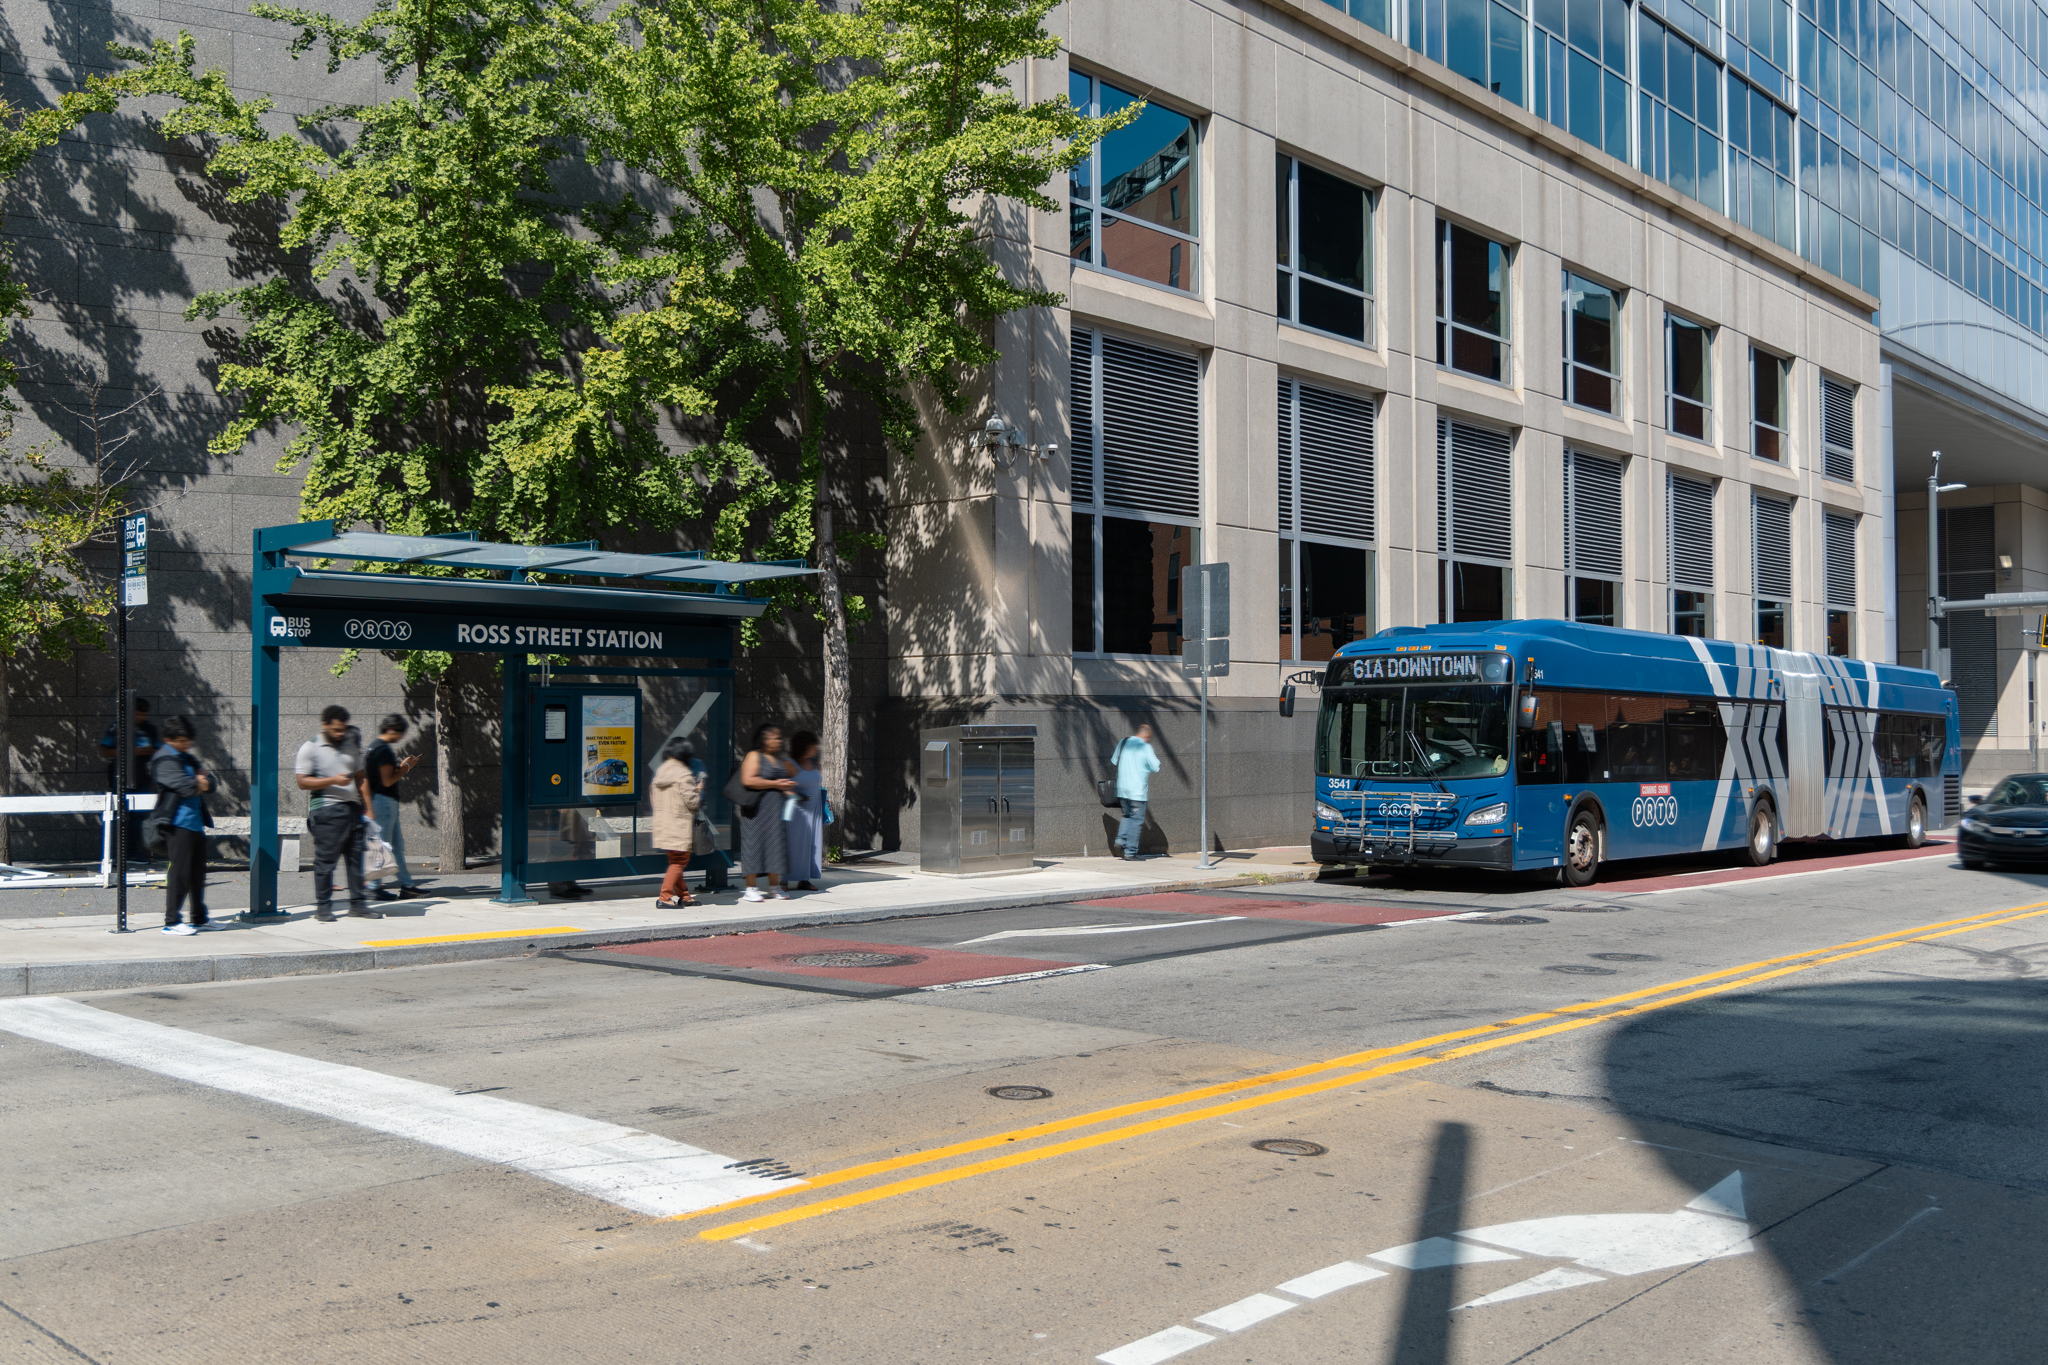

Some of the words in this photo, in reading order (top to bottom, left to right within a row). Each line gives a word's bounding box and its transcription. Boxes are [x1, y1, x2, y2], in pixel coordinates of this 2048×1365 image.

[126, 519, 136, 530] BUS
[126, 530, 136, 540] STOP
[287, 617, 311, 628] BUS
[287, 628, 311, 638] STOP
[346, 620, 411, 639] PRTX
[458, 623, 510, 644] ROSS
[515, 626, 583, 647] STREET
[586, 629, 663, 649] STATION
[1353, 659, 1384, 679] 61A
[1387, 655, 1477, 678] DOWNTOWN
[1328, 778, 1350, 789] 3541
[1633, 798, 1676, 825] PRTX
